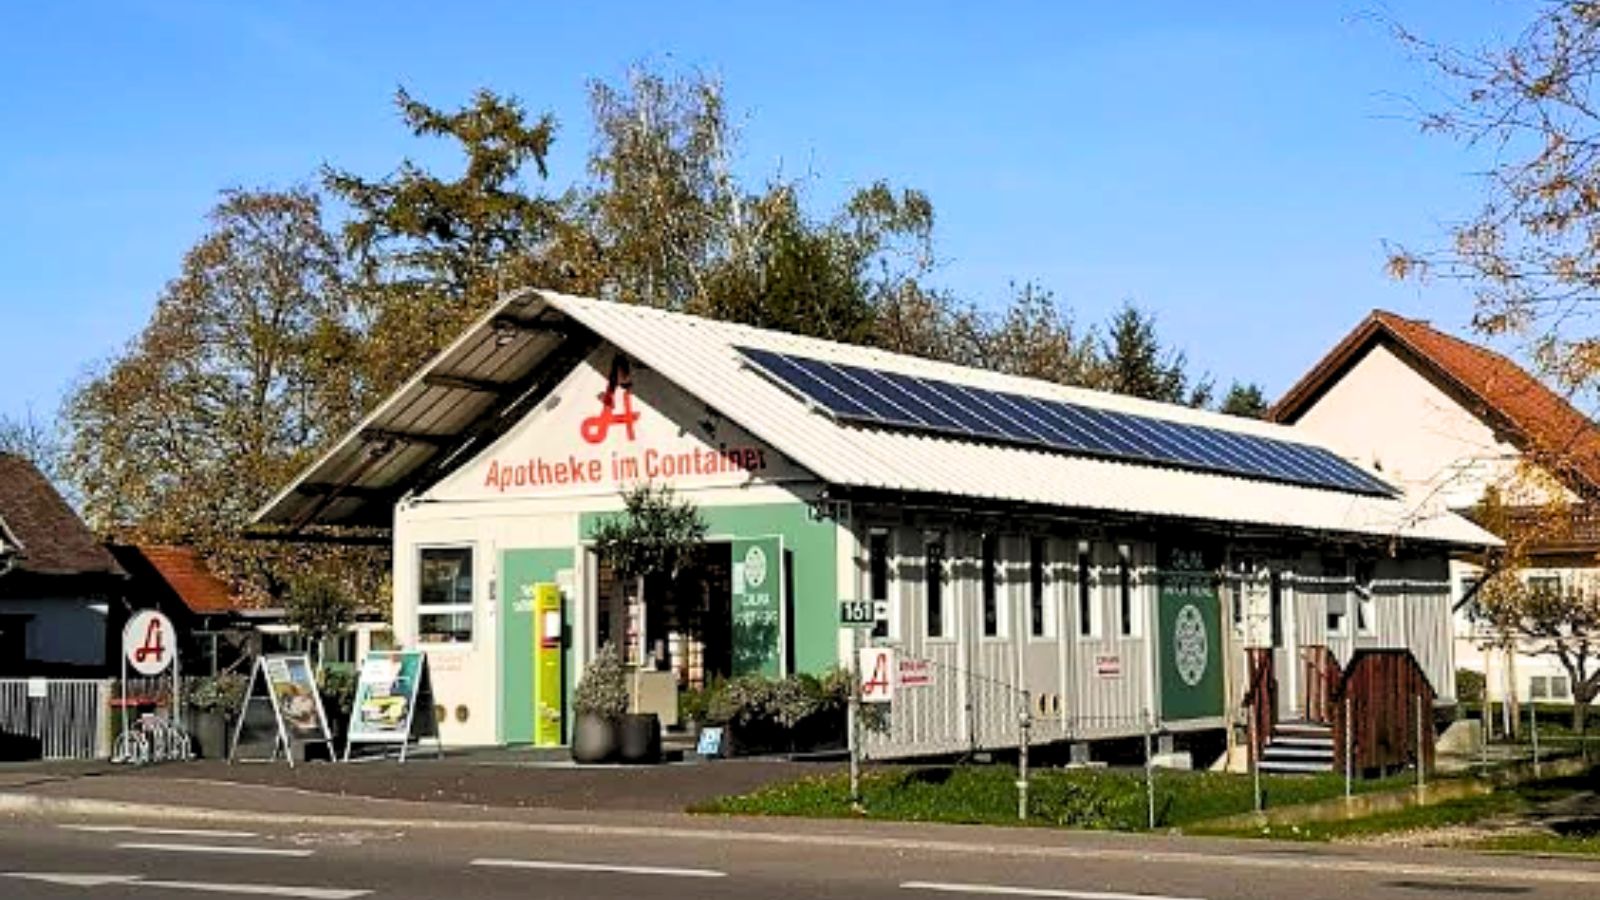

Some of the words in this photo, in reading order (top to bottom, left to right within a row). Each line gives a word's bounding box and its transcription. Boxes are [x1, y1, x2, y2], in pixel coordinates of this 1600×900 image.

[484, 455, 602, 492] Apotheke
[612, 451, 639, 481] im
[645, 442, 767, 478] Container
